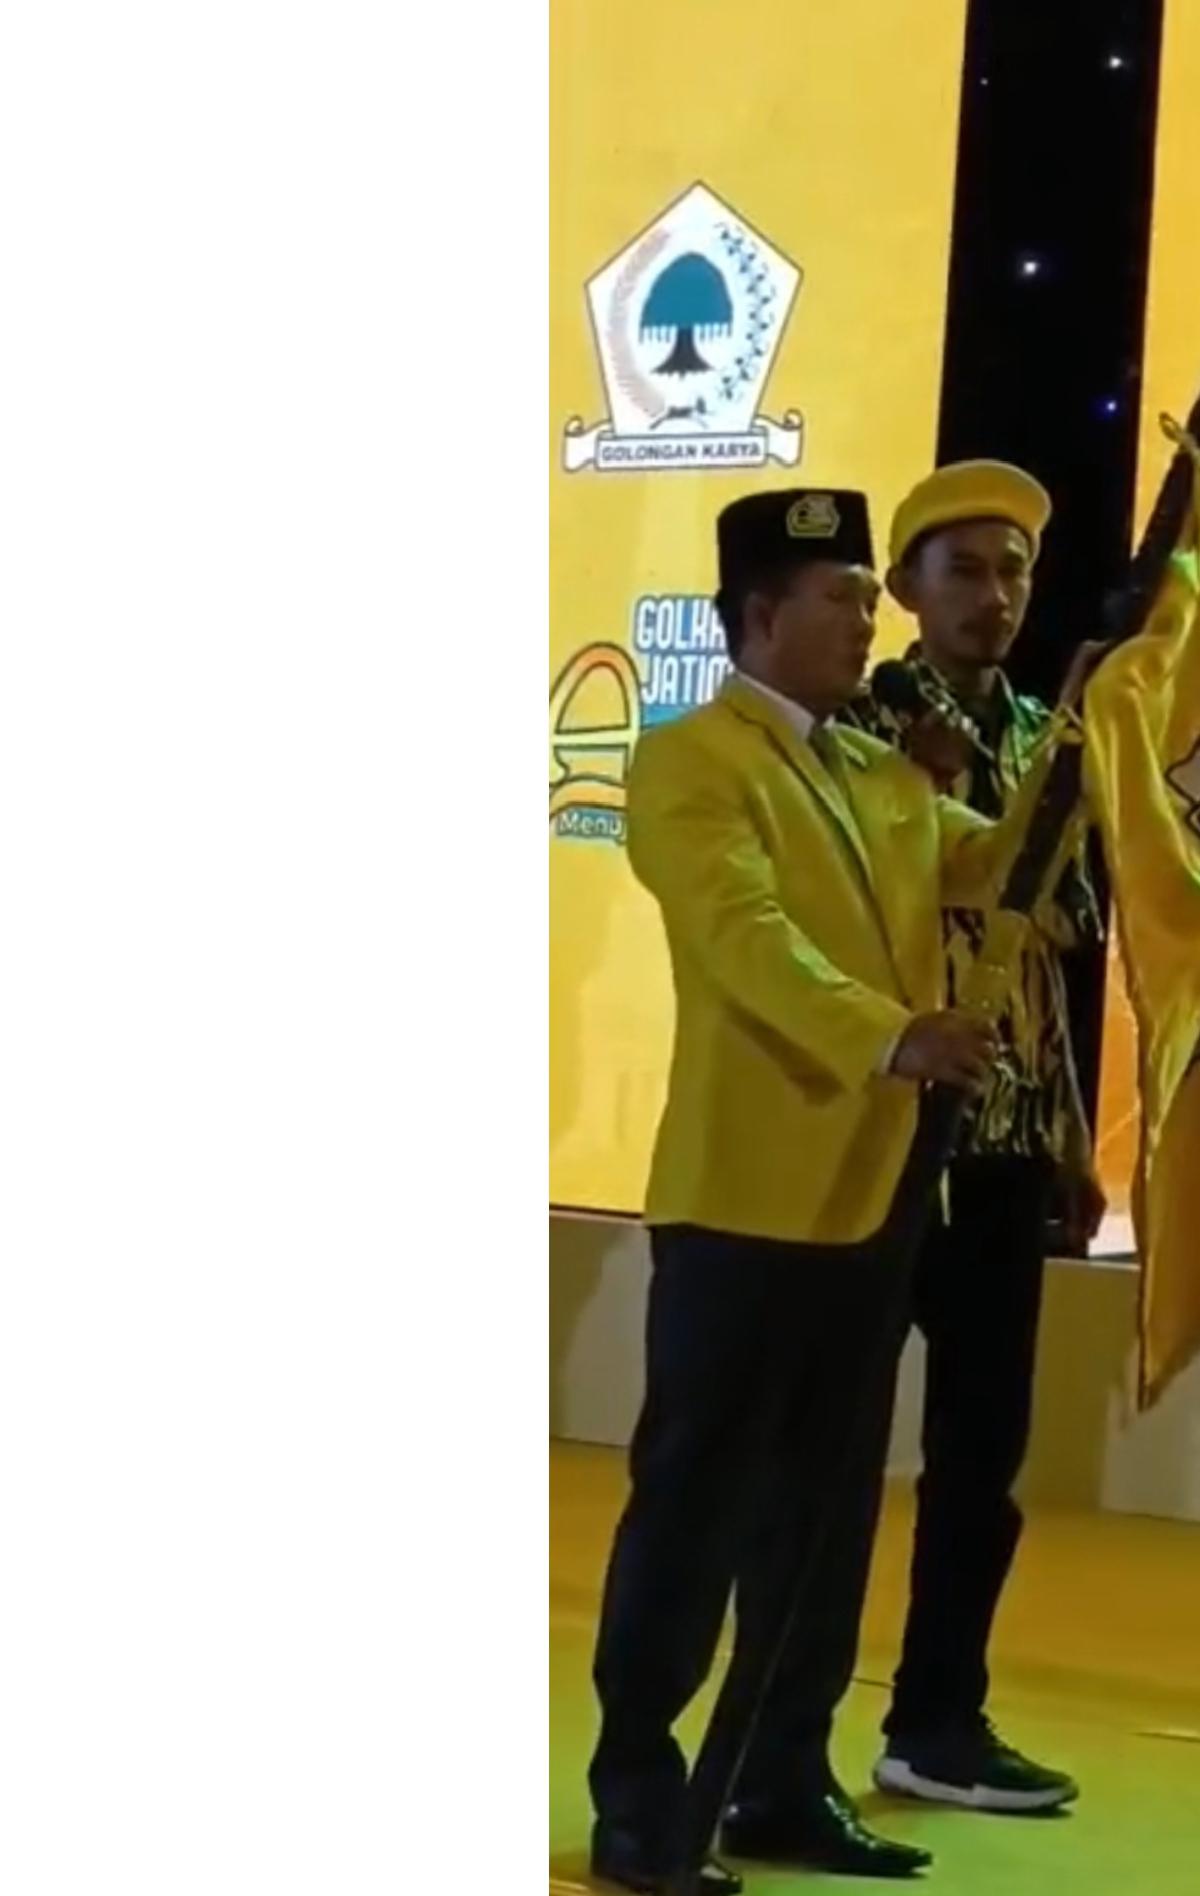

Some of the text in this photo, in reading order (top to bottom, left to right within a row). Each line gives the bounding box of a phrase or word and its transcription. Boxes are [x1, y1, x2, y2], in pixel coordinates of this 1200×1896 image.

[601, 441, 761, 462] GOLONGAN KARYA
[636, 598, 727, 651] GOLKA
